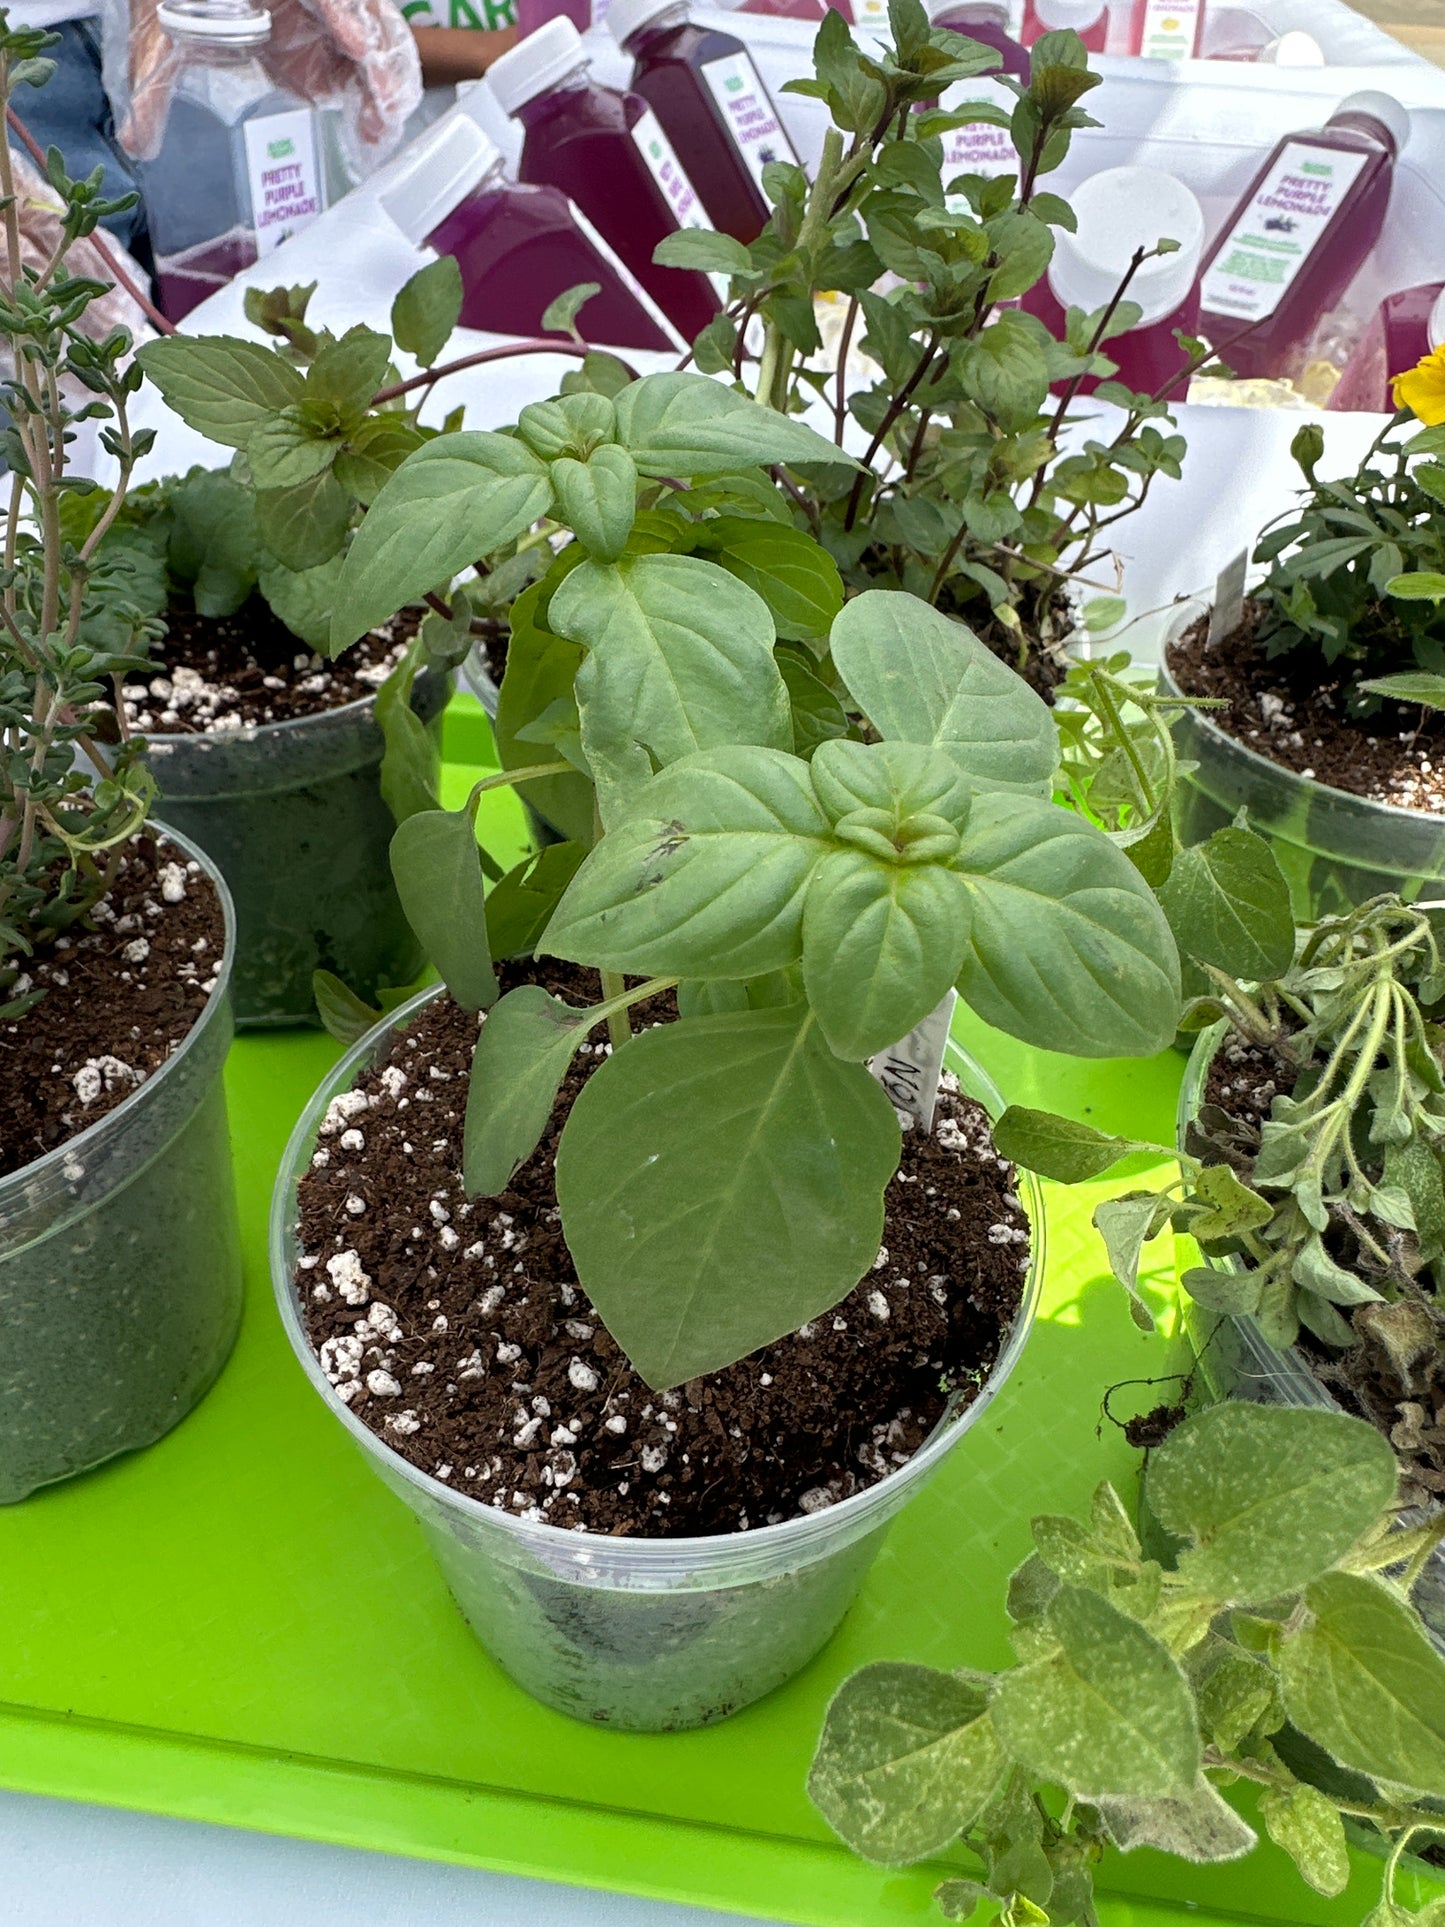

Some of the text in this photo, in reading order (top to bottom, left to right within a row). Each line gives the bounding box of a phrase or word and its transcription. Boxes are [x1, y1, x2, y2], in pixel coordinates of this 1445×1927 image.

[956, 132, 1004, 146] PURPLE
[946, 147, 1017, 163] LEMONADE
[261, 162, 302, 188] PRETTY
[1280, 175, 1332, 191] PRETTY
[264, 181, 306, 206] PURPLE
[1276, 186, 1327, 204] PURPLE
[257, 197, 317, 228] LEMONADE
[1256, 194, 1332, 216] LEMONADE
